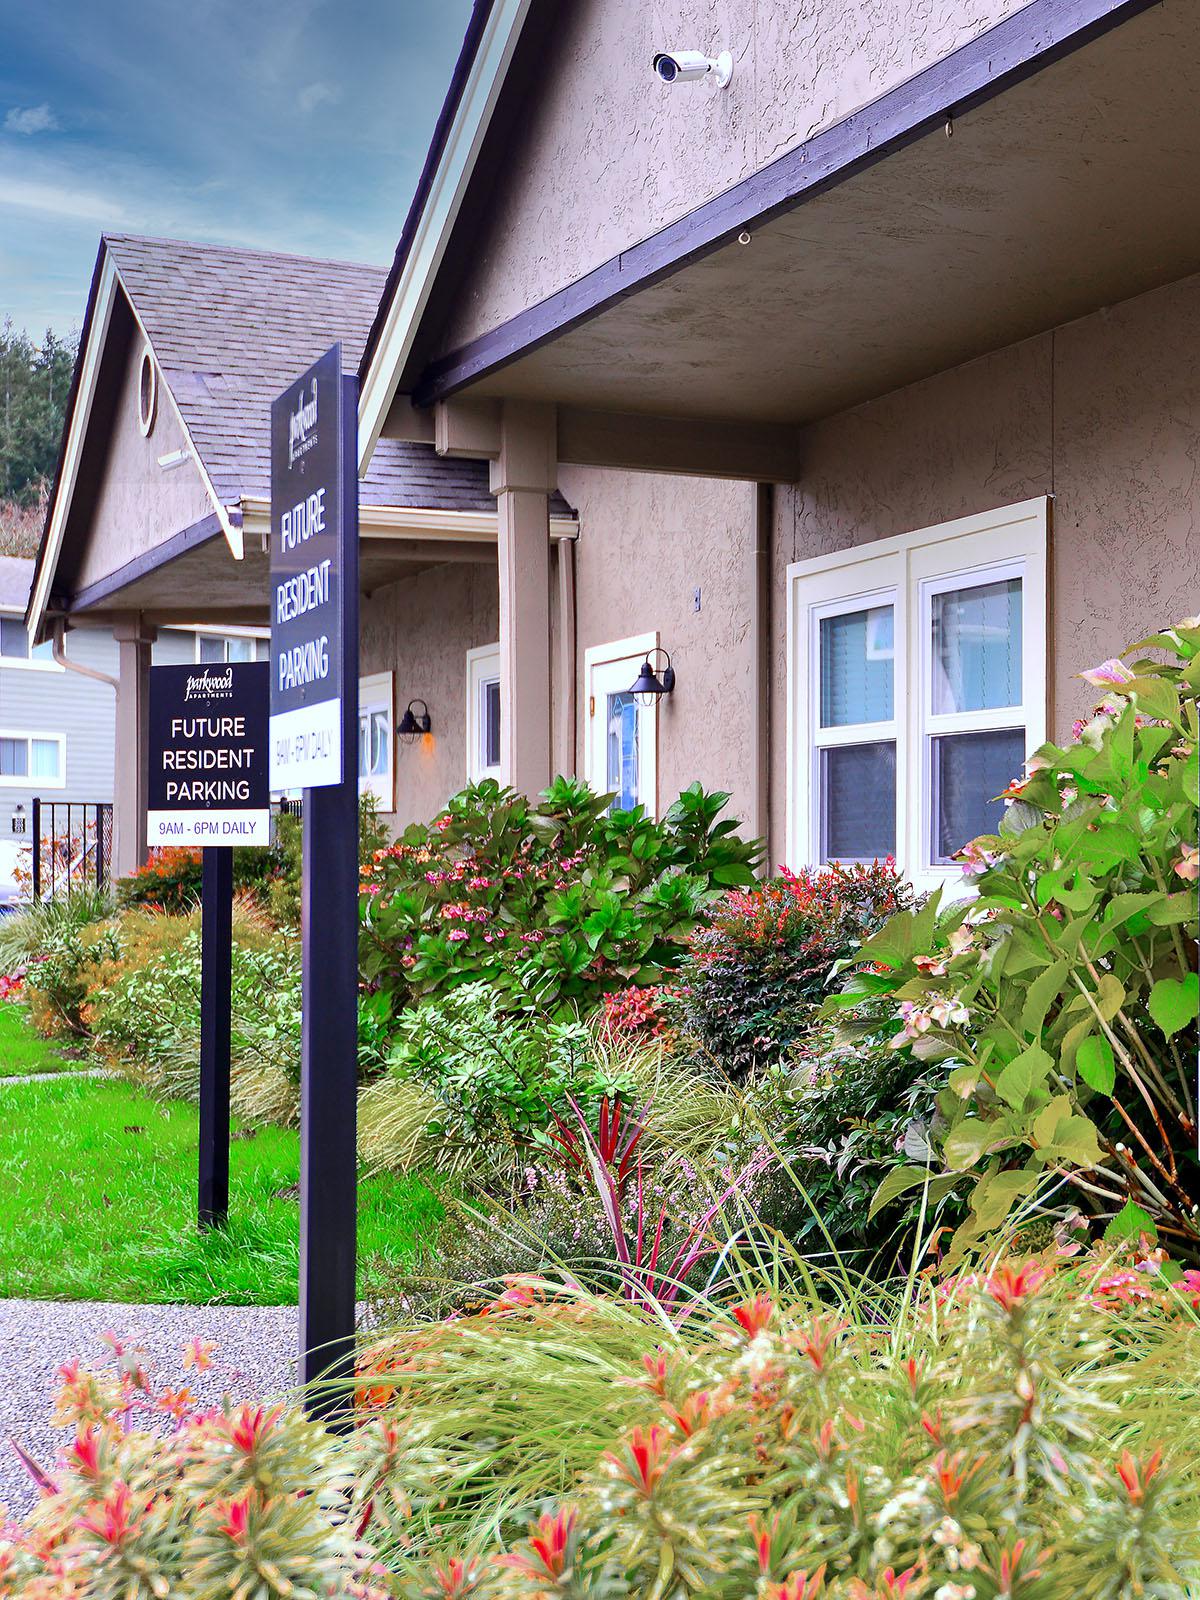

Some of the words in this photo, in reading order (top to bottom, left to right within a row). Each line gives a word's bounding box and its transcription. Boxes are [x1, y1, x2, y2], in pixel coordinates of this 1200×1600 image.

[281, 488, 326, 554] FUTURE
[276, 558, 332, 625] RESIDENT
[279, 635, 329, 693] PARKING
[184, 667, 233, 702] parkwood
[188, 692, 233, 700] APARTMENTS
[171, 717, 246, 739] FUTURE
[163, 748, 255, 770] RESIDENT
[166, 780, 250, 802] PARKING
[158, 822, 184, 835] 9AM
[193, 822, 219, 835] 6PM
[222, 821, 257, 834] DAILY
